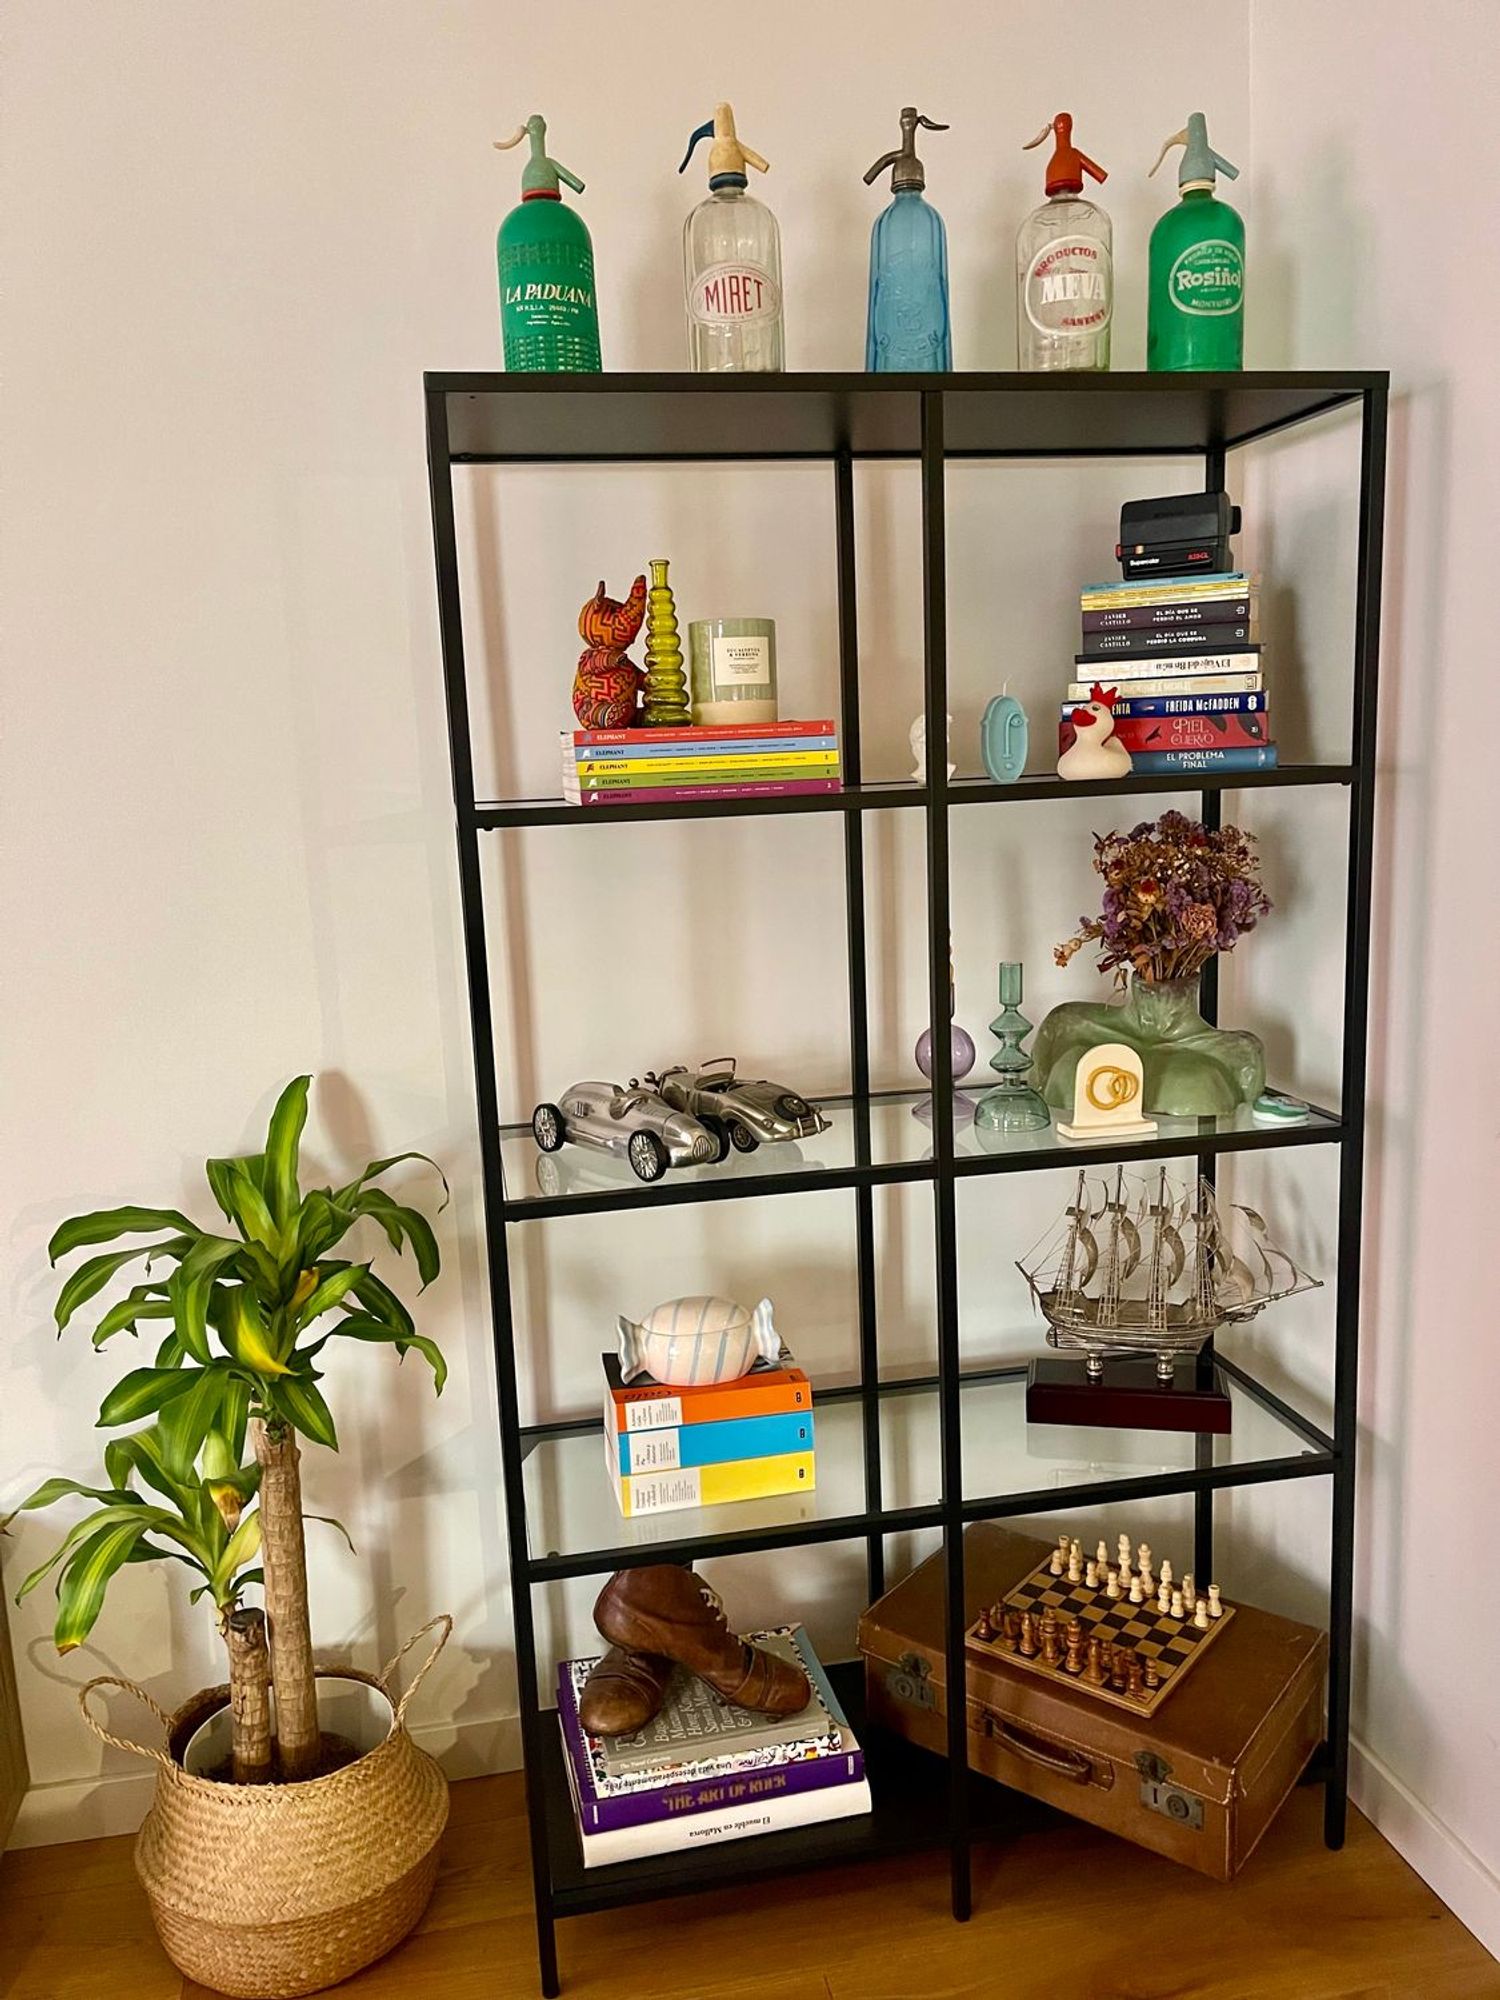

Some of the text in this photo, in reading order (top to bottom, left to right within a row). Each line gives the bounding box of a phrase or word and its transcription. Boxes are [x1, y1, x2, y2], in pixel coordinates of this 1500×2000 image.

[1034, 246, 1098, 277] PRODUCTOS
[1176, 267, 1241, 291] Rosiñol
[505, 283, 591, 308] LA PADUANA
[704, 275, 762, 314] MIRET
[1112, 697, 1240, 715] ENTA FREIDA McFADDEN
[1173, 718, 1209, 733] PIEL
[1170, 733, 1214, 747] CUERVO
[1166, 751, 1225, 761] EL PROBLEMA
[1182, 760, 1207, 768] FINAL
[603, 792, 632, 800] ELEPHANT
[624, 1768, 697, 1786] desesperadamente
[662, 1793, 695, 1812] THE
[698, 1787, 724, 1805] ART
[728, 1784, 746, 1798] OF
[763, 1816, 771, 1824] El
[689, 1826, 722, 1837] Mallorca
